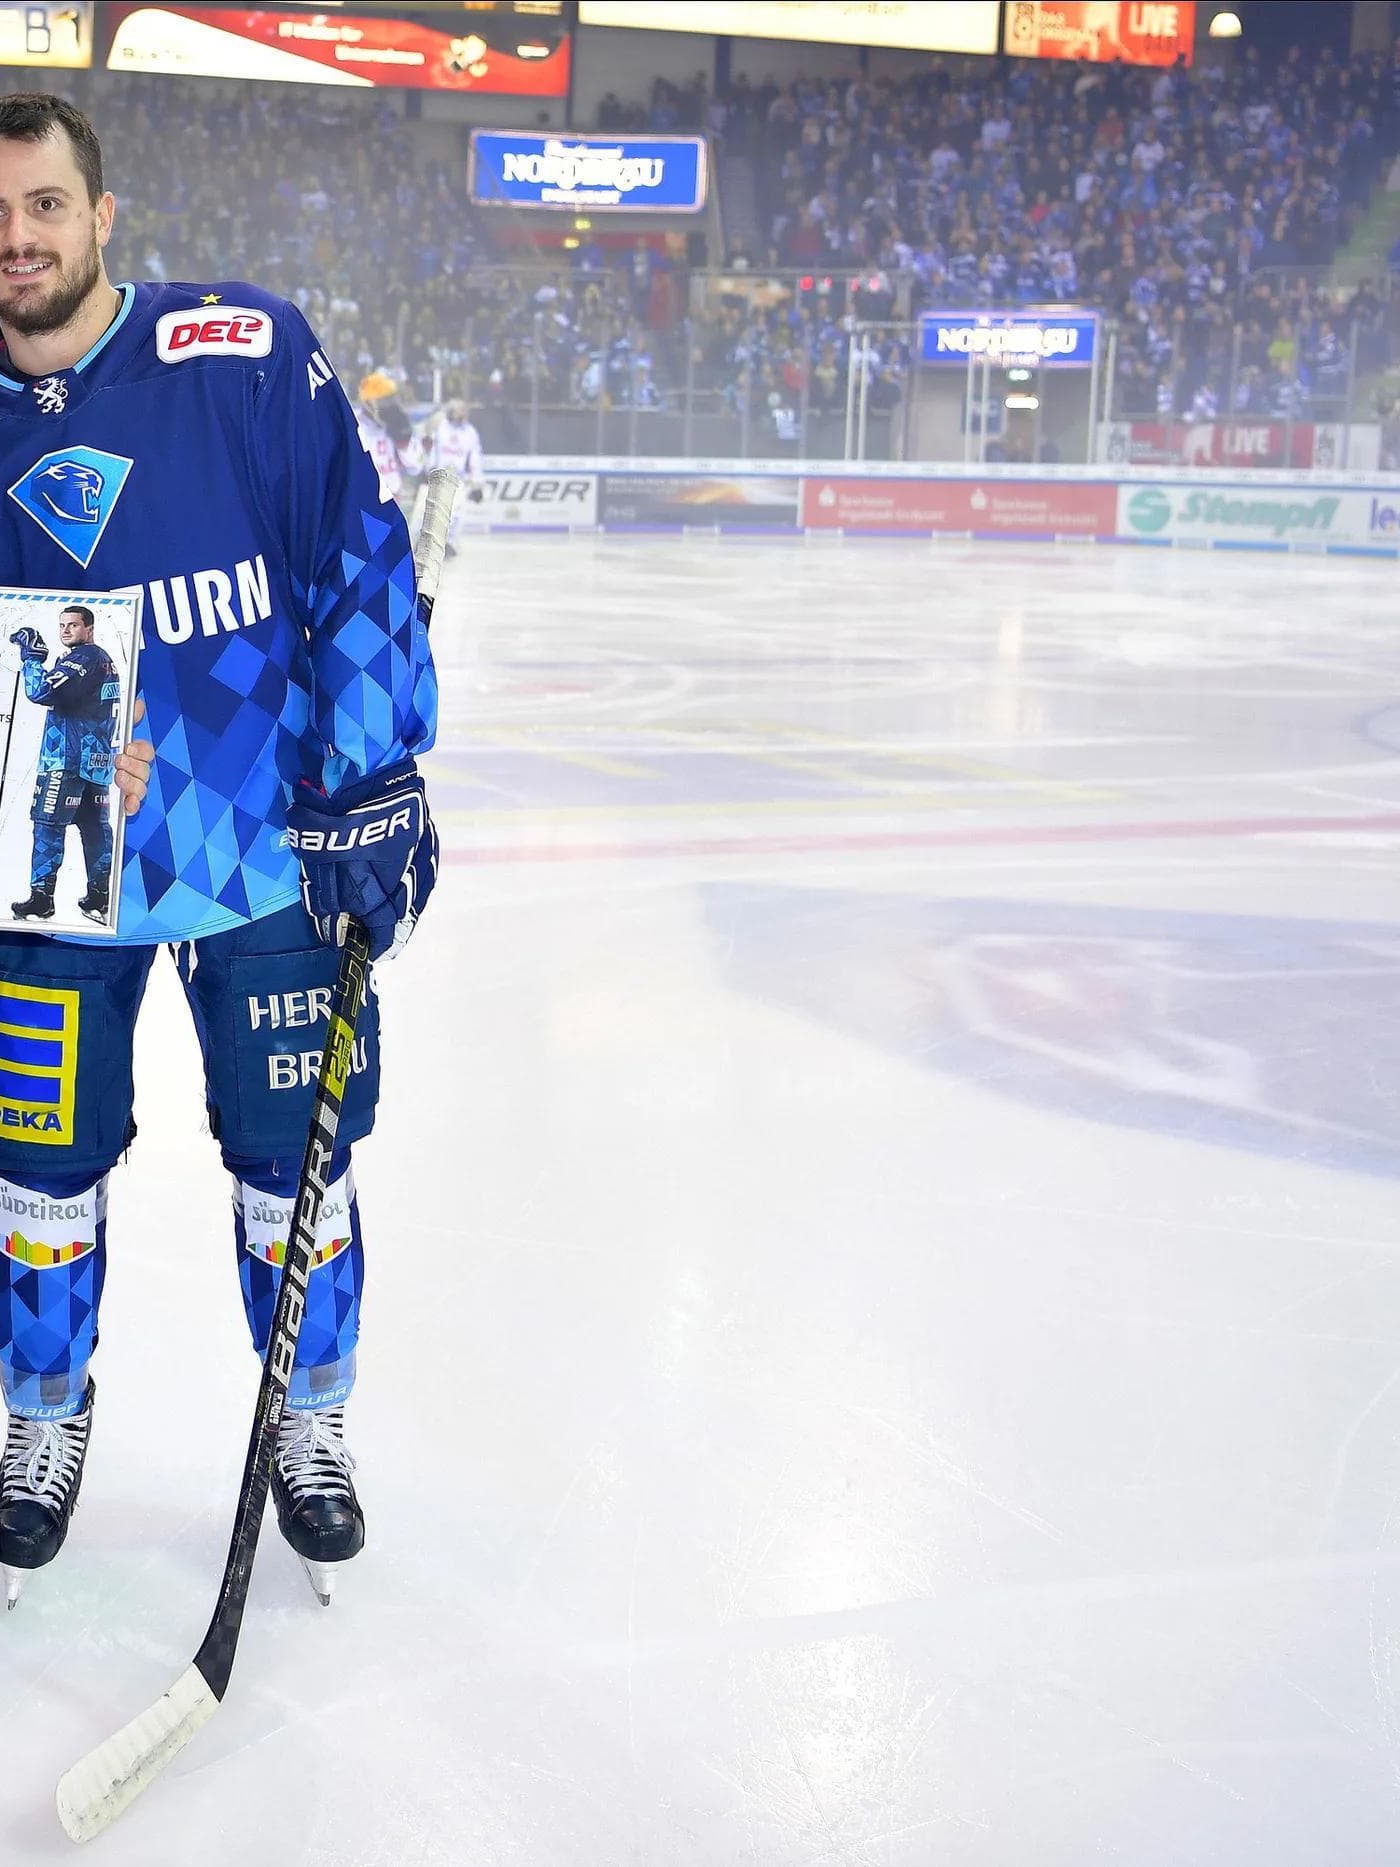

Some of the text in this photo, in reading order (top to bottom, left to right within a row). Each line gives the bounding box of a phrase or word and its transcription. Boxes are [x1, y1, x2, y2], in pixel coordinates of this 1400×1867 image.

[167, 314, 264, 351] DEL
[43, 770, 63, 814] SATURN
[286, 807, 411, 851] BAUER
[10, 1401, 79, 1418] BAUER
